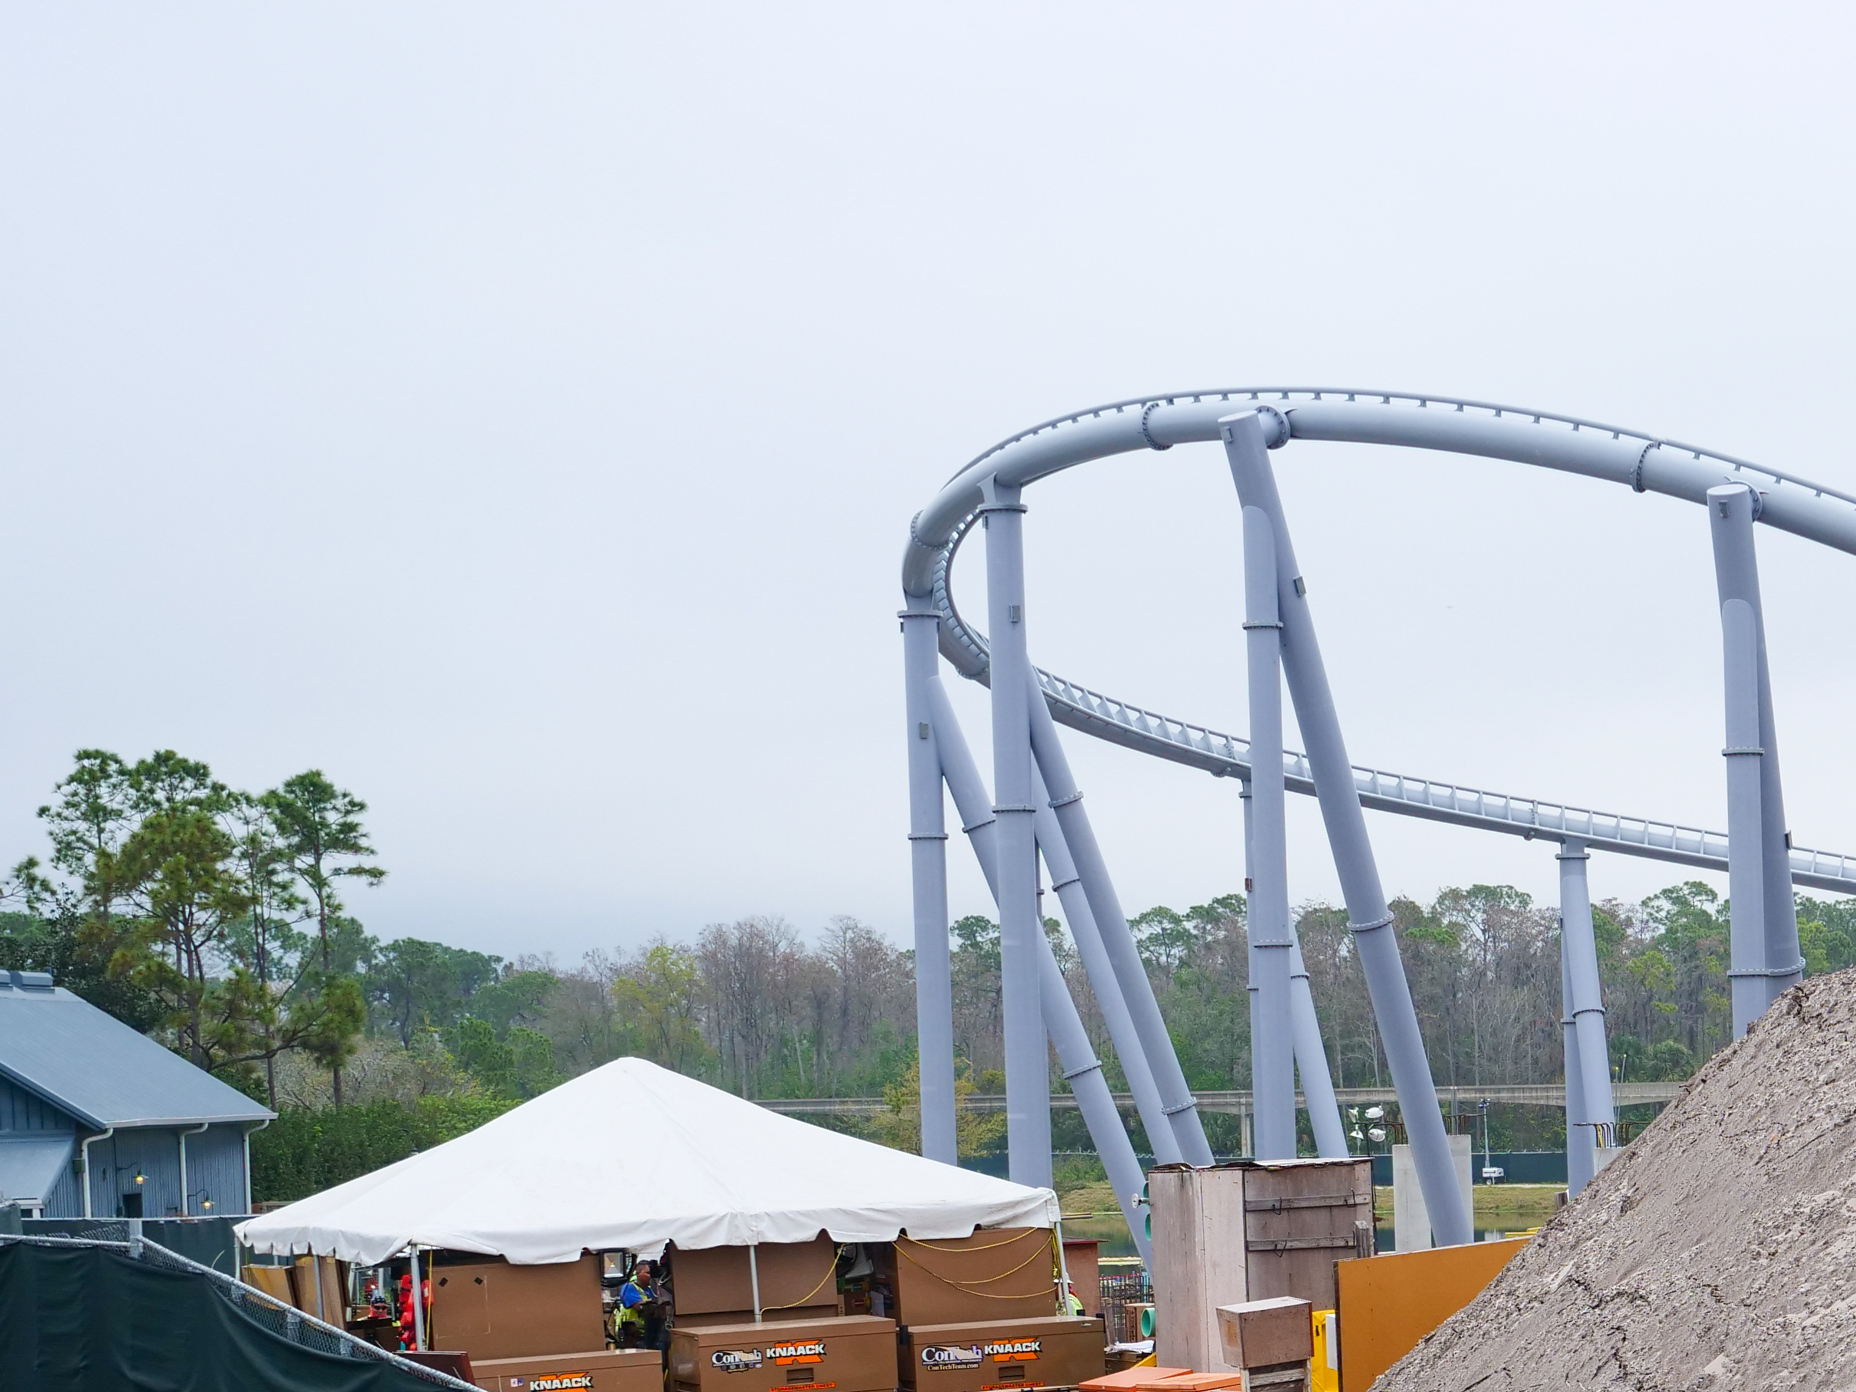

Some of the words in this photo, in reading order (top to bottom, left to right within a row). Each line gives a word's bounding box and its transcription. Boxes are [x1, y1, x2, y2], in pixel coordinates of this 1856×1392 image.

[711, 1348, 763, 1364] Conh
[766, 1344, 826, 1359] KNAACK
[921, 1344, 983, 1362] Conh
[984, 1341, 1041, 1355] KNAACK
[529, 1376, 593, 1392] KNAACK
